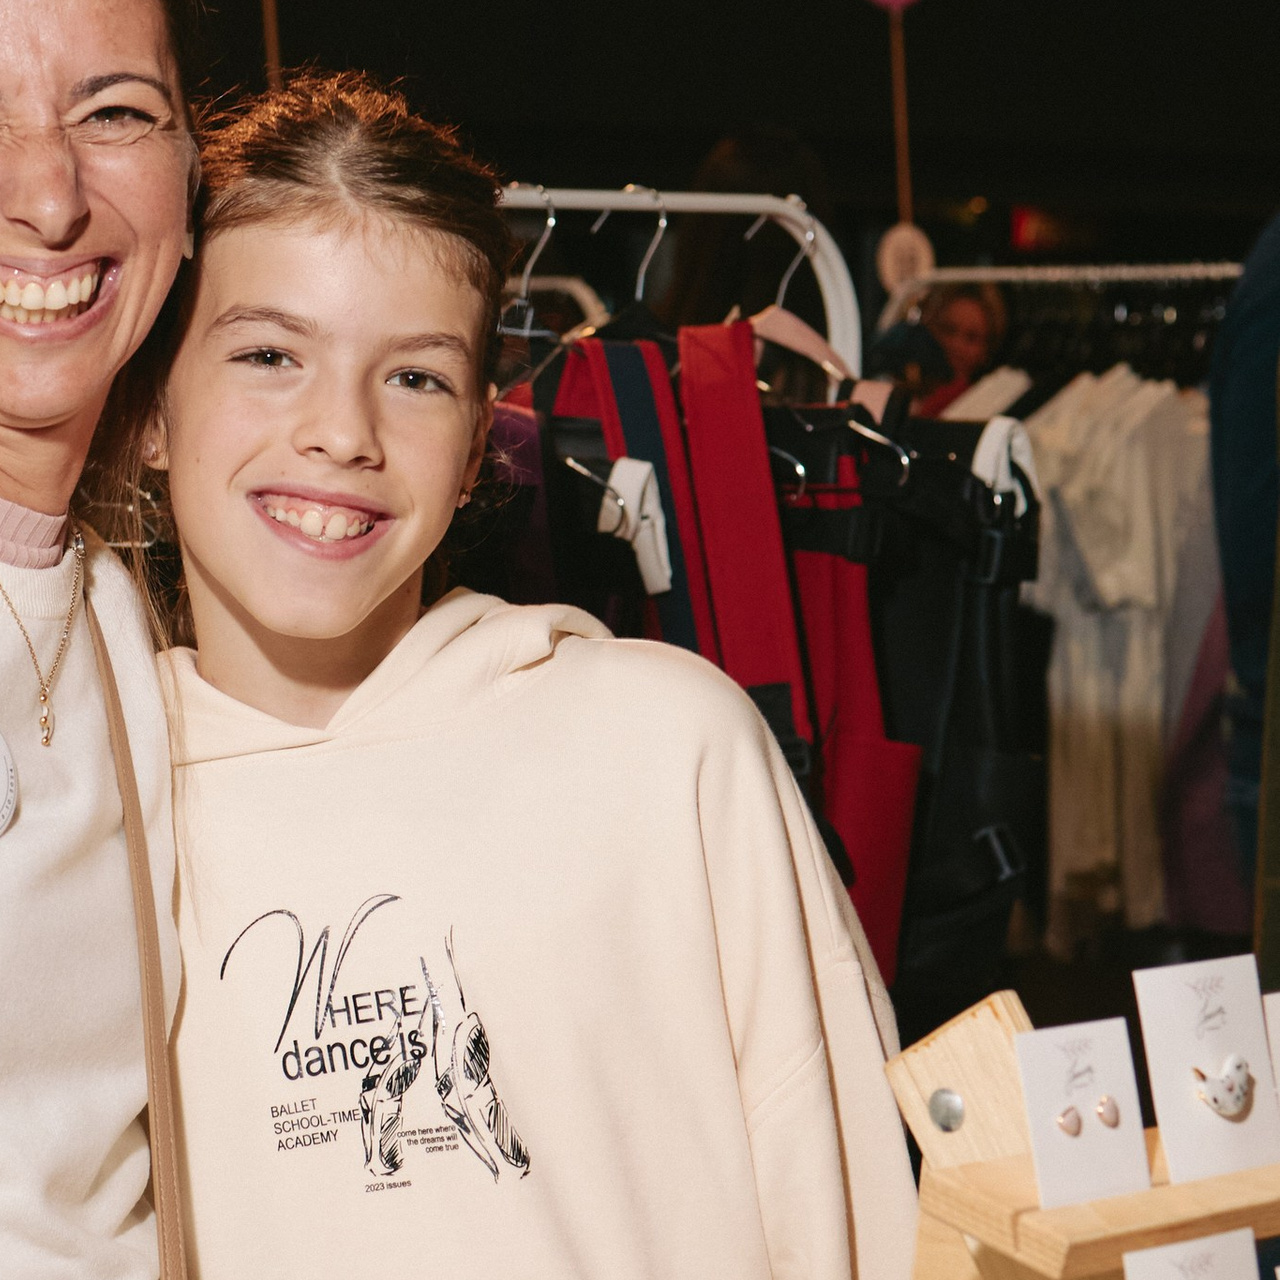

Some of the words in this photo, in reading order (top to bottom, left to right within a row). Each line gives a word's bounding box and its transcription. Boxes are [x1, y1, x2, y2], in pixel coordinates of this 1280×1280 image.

[220, 893, 423, 1054] WHERE
[281, 1035, 392, 1081] dance
[397, 1021, 428, 1062] is
[270, 1098, 317, 1118] BALLET
[273, 1108, 361, 1135] SCHOOL-TIME
[396, 1129, 417, 1138] come
[418, 1126, 433, 1136] here
[435, 1124, 456, 1133] where
[277, 1129, 339, 1152] ACADEMY
[406, 1138, 418, 1146] the
[420, 1135, 445, 1145] dreams
[446, 1133, 458, 1141] will
[425, 1145, 444, 1153] come
[445, 1143, 459, 1151] true
[365, 1182, 385, 1193] 2023
[386, 1180, 412, 1190] issues
